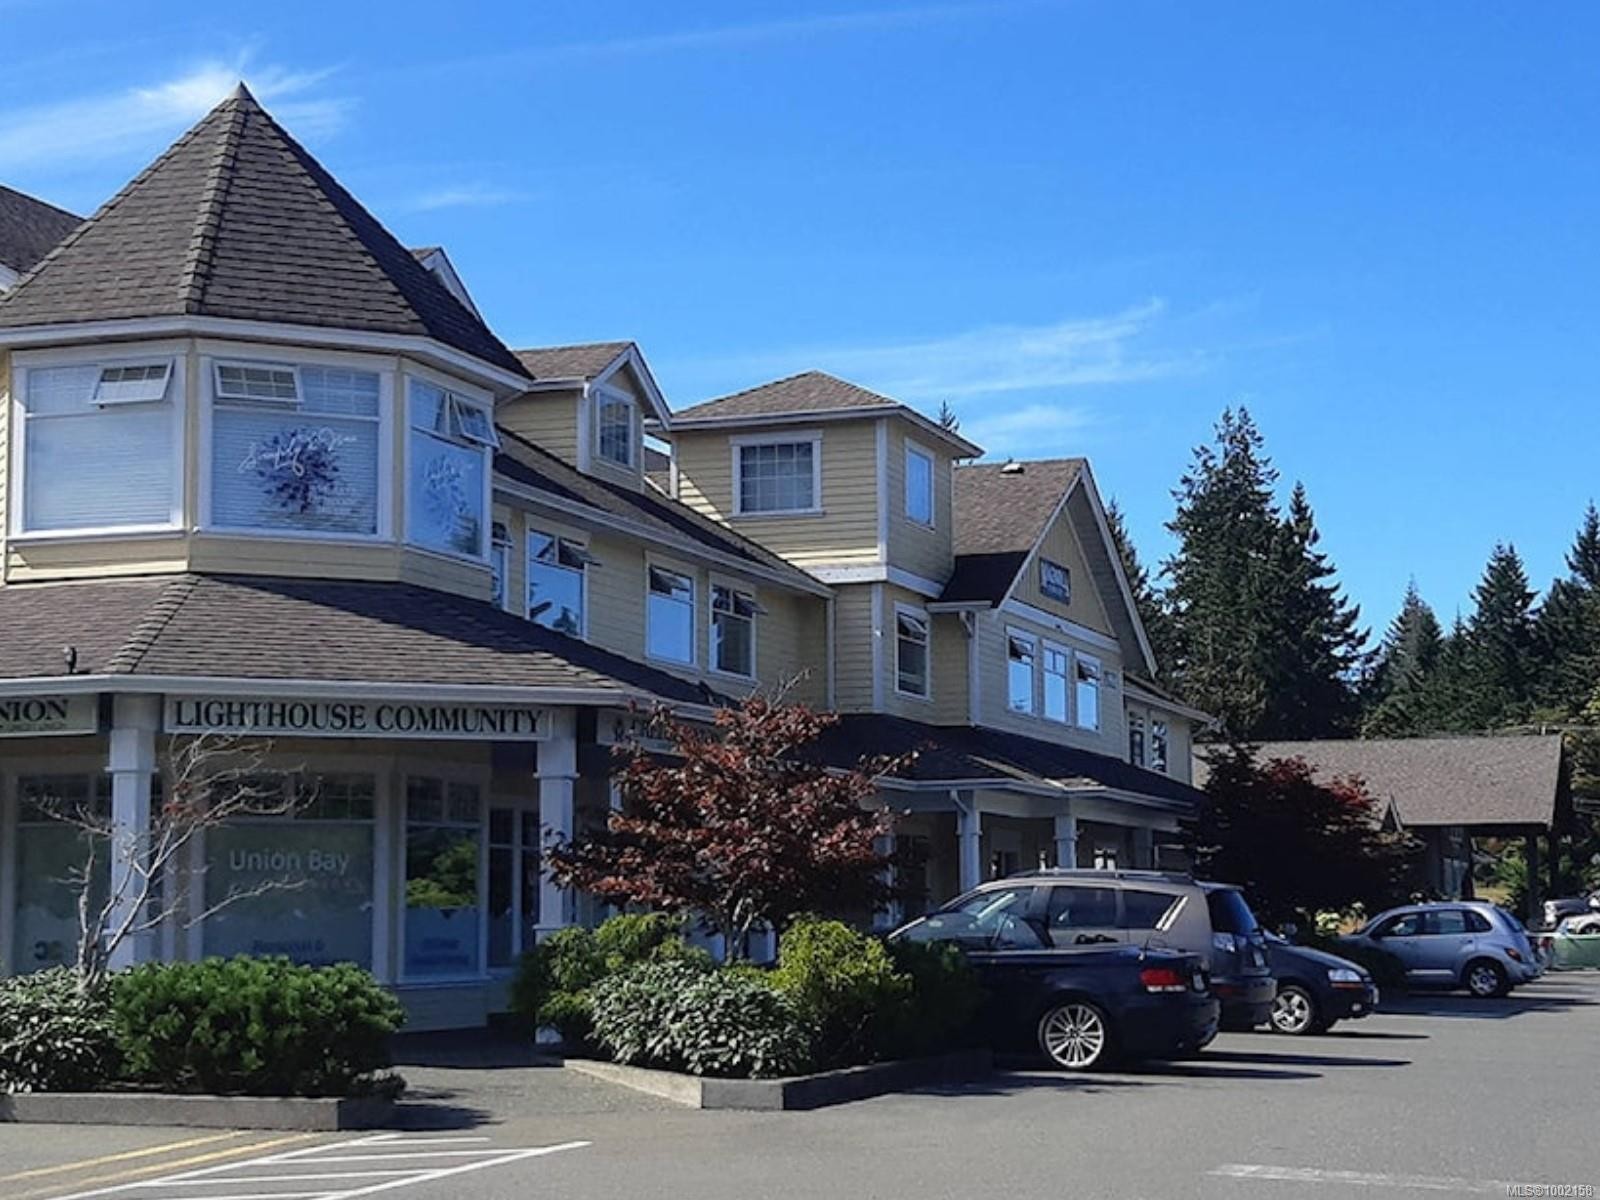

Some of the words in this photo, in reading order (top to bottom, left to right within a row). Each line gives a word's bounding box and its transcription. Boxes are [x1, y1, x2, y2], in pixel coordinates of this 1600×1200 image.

[174, 700, 366, 731] LIGHTHOUSE
[374, 705, 545, 733] COMMUNITY
[228, 847, 301, 872] Union
[309, 848, 351, 876] Bay
